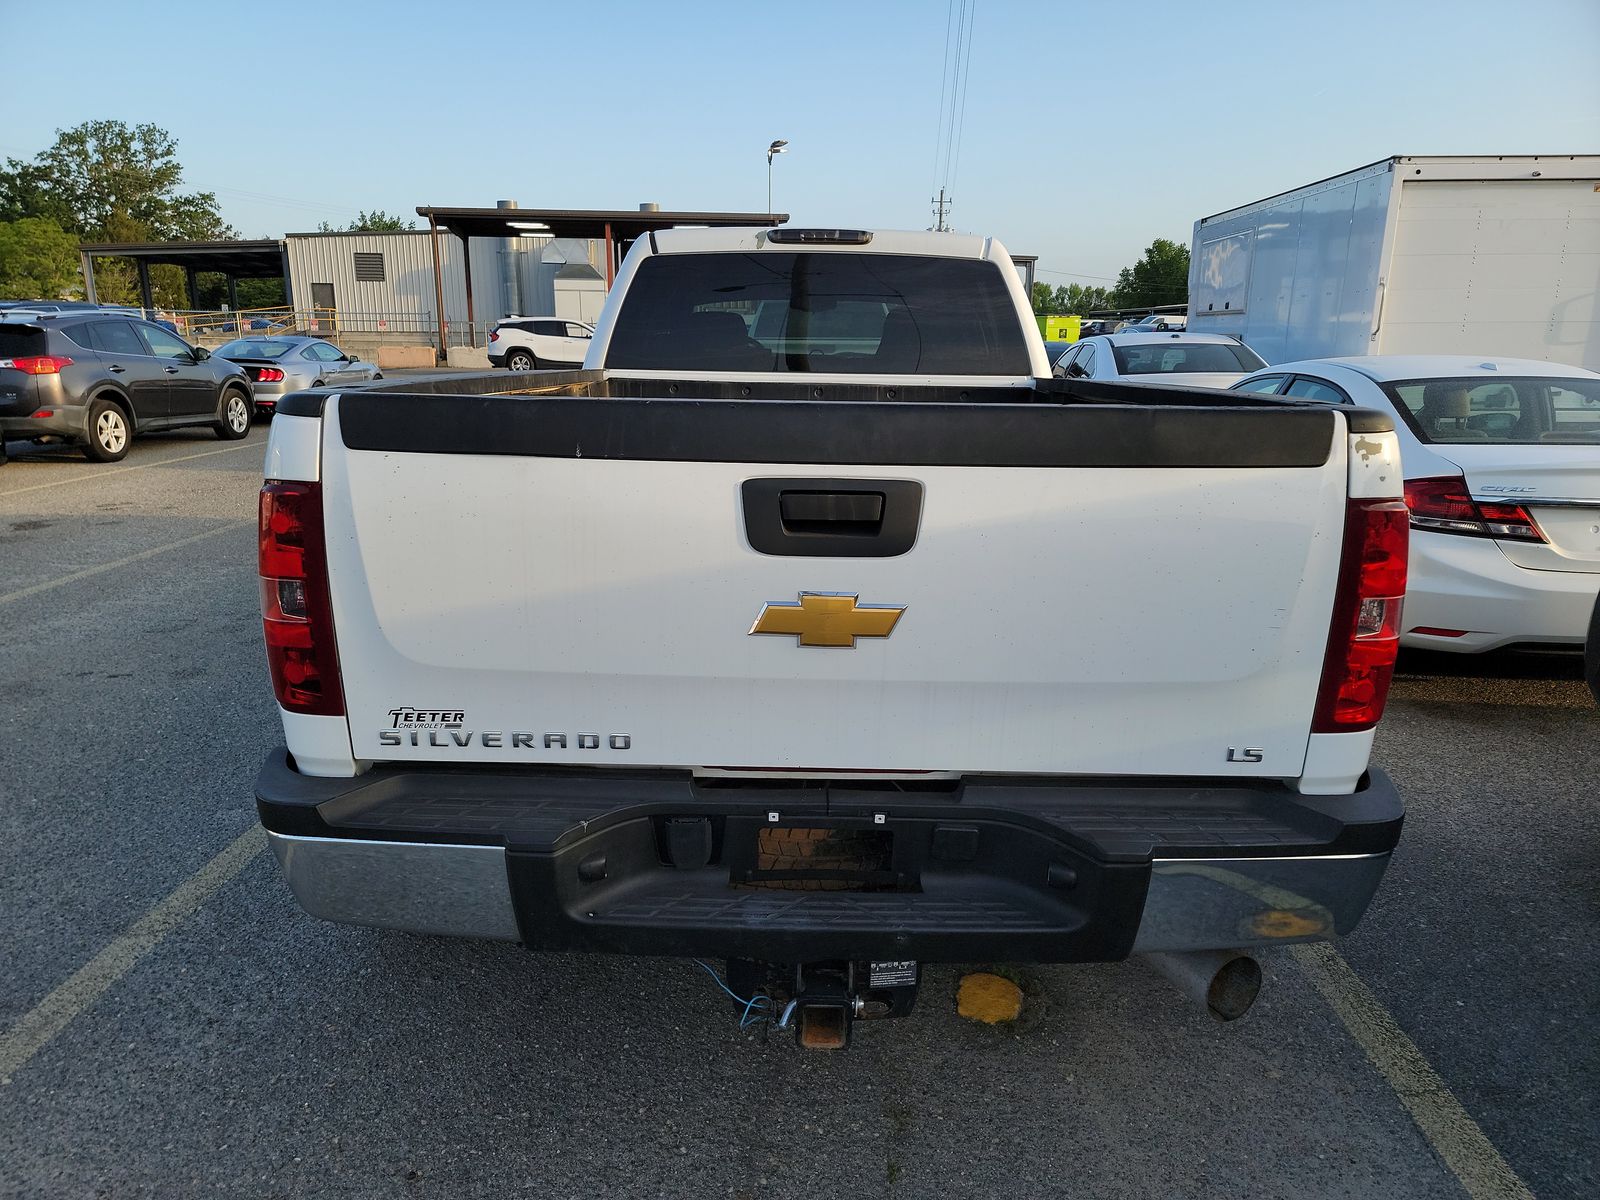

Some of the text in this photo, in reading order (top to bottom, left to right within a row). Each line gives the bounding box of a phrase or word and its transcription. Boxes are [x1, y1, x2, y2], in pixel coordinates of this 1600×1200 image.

[391, 712, 465, 728] TEETER
[380, 729, 632, 750] SILVERADO
[1226, 746, 1264, 763] LS
